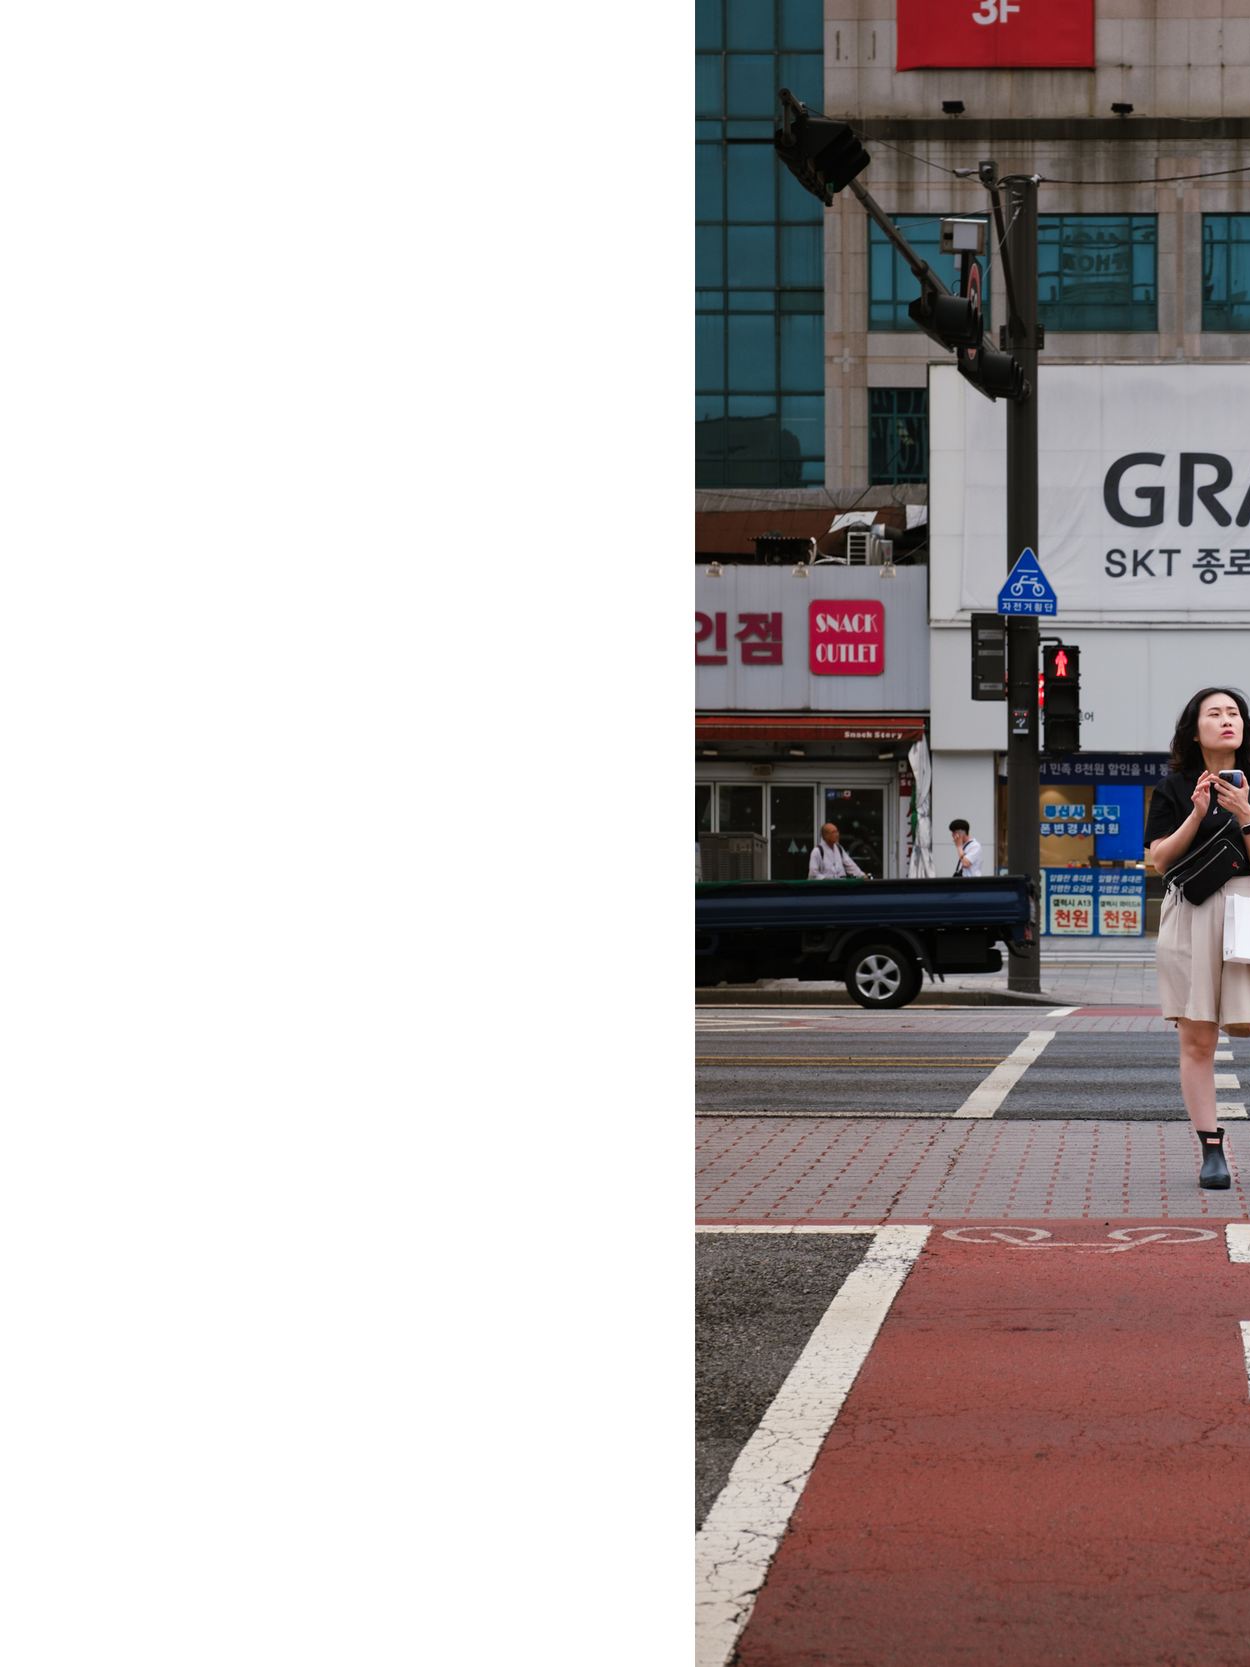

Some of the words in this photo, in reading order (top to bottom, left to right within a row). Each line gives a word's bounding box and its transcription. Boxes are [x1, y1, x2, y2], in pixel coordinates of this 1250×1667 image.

[971, 0, 1021, 25] 3F
[1104, 547, 1181, 579] SKT
[1002, 601, 1054, 613] 자전거횡단
[815, 613, 878, 633] SNACK
[815, 643, 879, 663] OUTLET
[844, 730, 873, 739] Snack
[874, 731, 903, 740] Story
[1049, 763, 1072, 776] 민족
[1074, 763, 1105, 776] 8천원
[1107, 763, 1142, 776] 할인을
[1144, 763, 1156, 776] 내
[1072, 874, 1094, 883] 휴대폰
[1120, 875, 1143, 884] 휴대폰
[1072, 885, 1094, 894] 요금제
[1120, 886, 1143, 895] 요금제
[1052, 898, 1076, 908] 갤럭시
[1077, 899, 1092, 907] A13
[1100, 900, 1118, 908] 갤럭시
[1054, 909, 1089, 928] 천원
[1103, 910, 1138, 929] 천원
